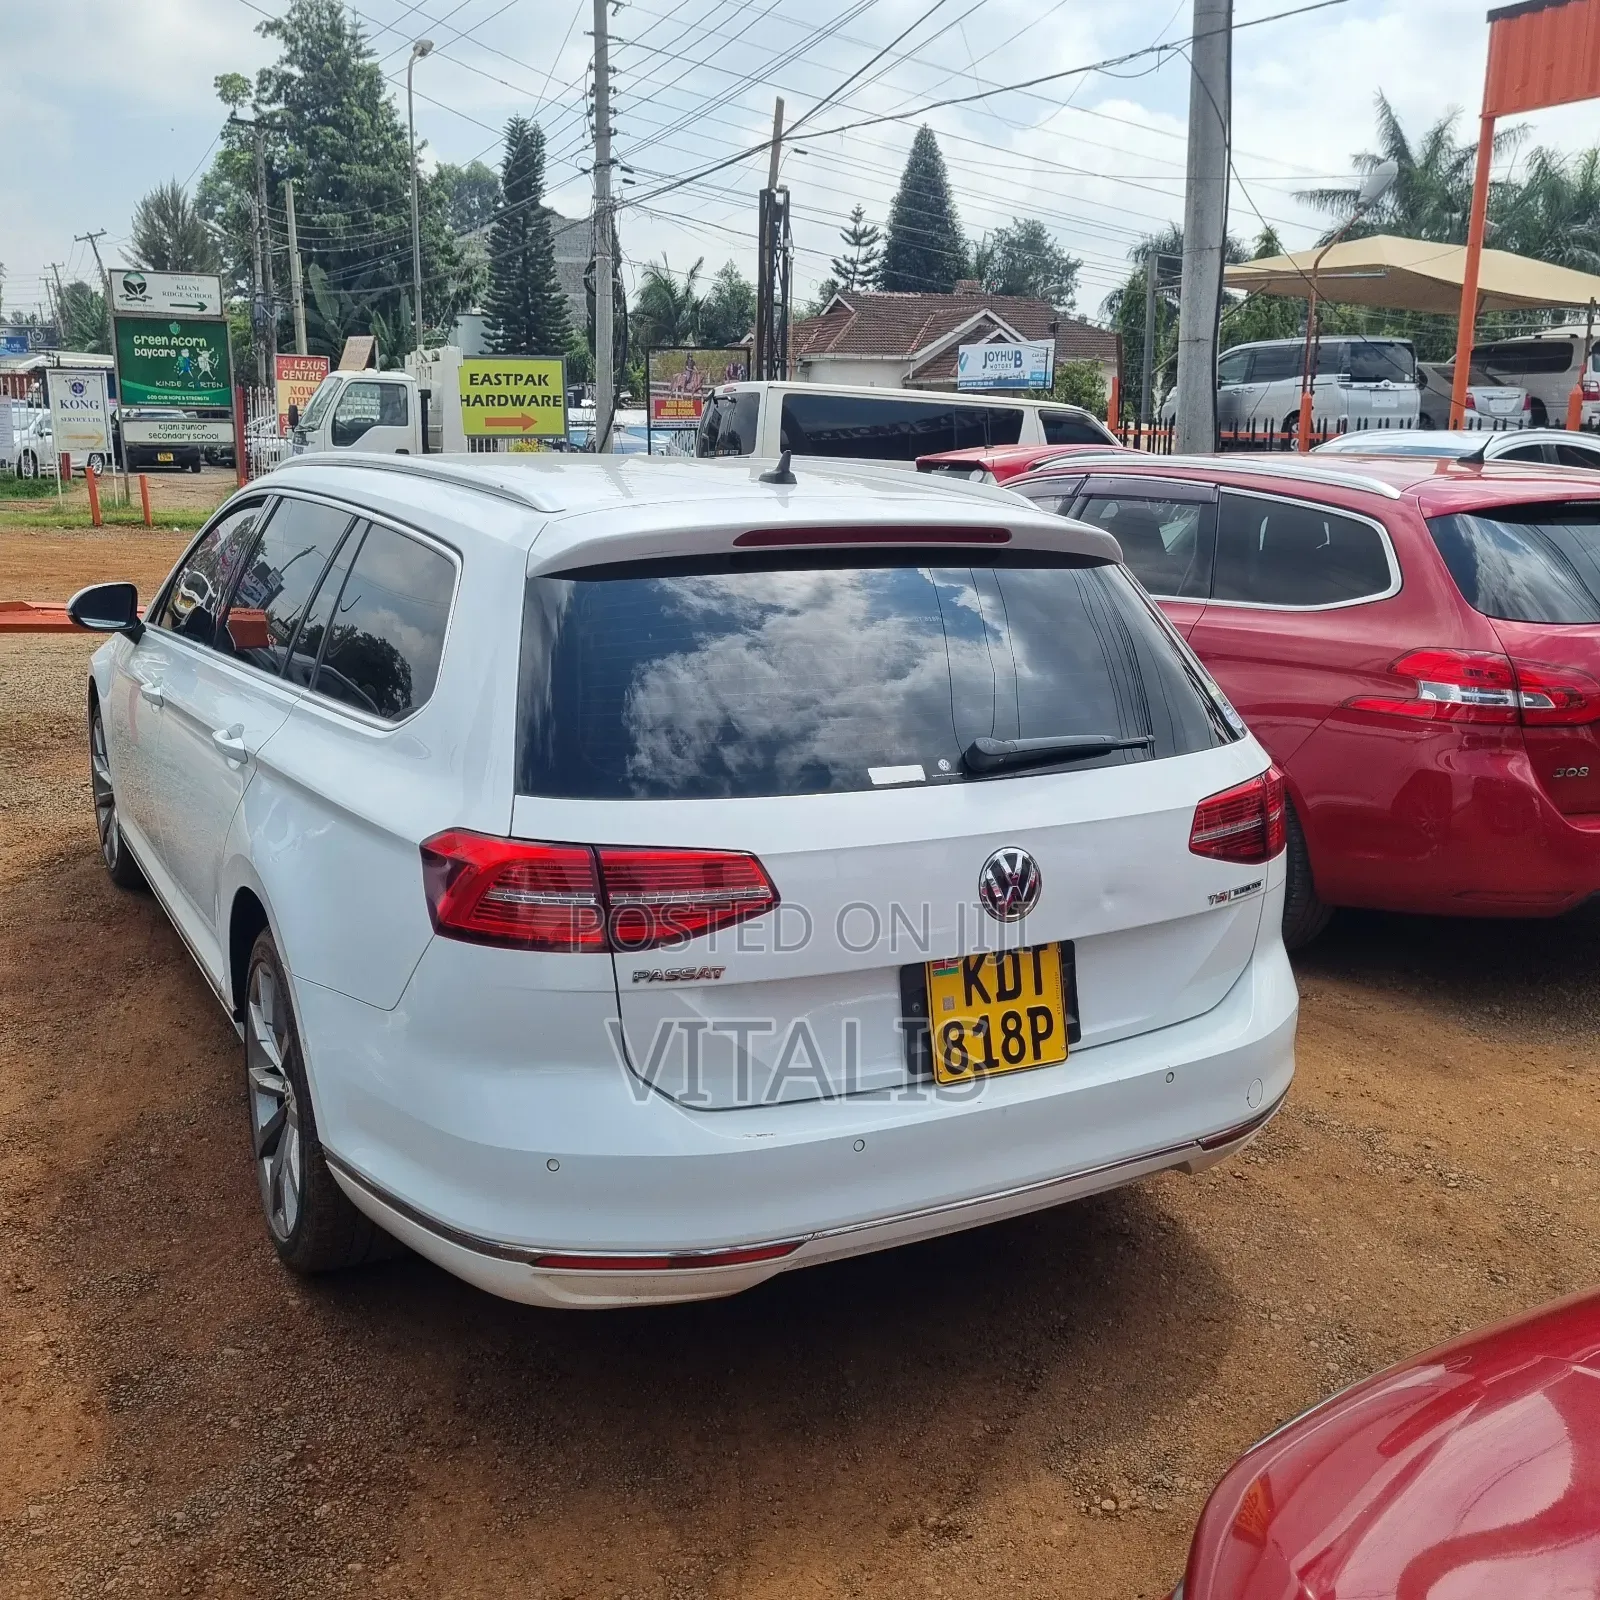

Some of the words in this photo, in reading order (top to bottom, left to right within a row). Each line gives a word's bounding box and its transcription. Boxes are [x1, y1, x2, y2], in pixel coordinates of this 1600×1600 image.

[134, 348, 176, 359] Daycare
[294, 360, 327, 370] LEXUS
[982, 350, 1023, 369] JOYHUB
[282, 370, 322, 380] CENTRE
[469, 373, 549, 387] EASTPAK
[290, 386, 315, 396] NOW
[60, 399, 99, 409] KONG
[288, 397, 311, 407] OPE
[461, 394, 562, 407] HARDWARE
[1553, 766, 1589, 777] 308
[632, 966, 726, 983] PASSAT
[962, 942, 1049, 1007] KDT
[942, 1005, 1054, 1075] 818P
